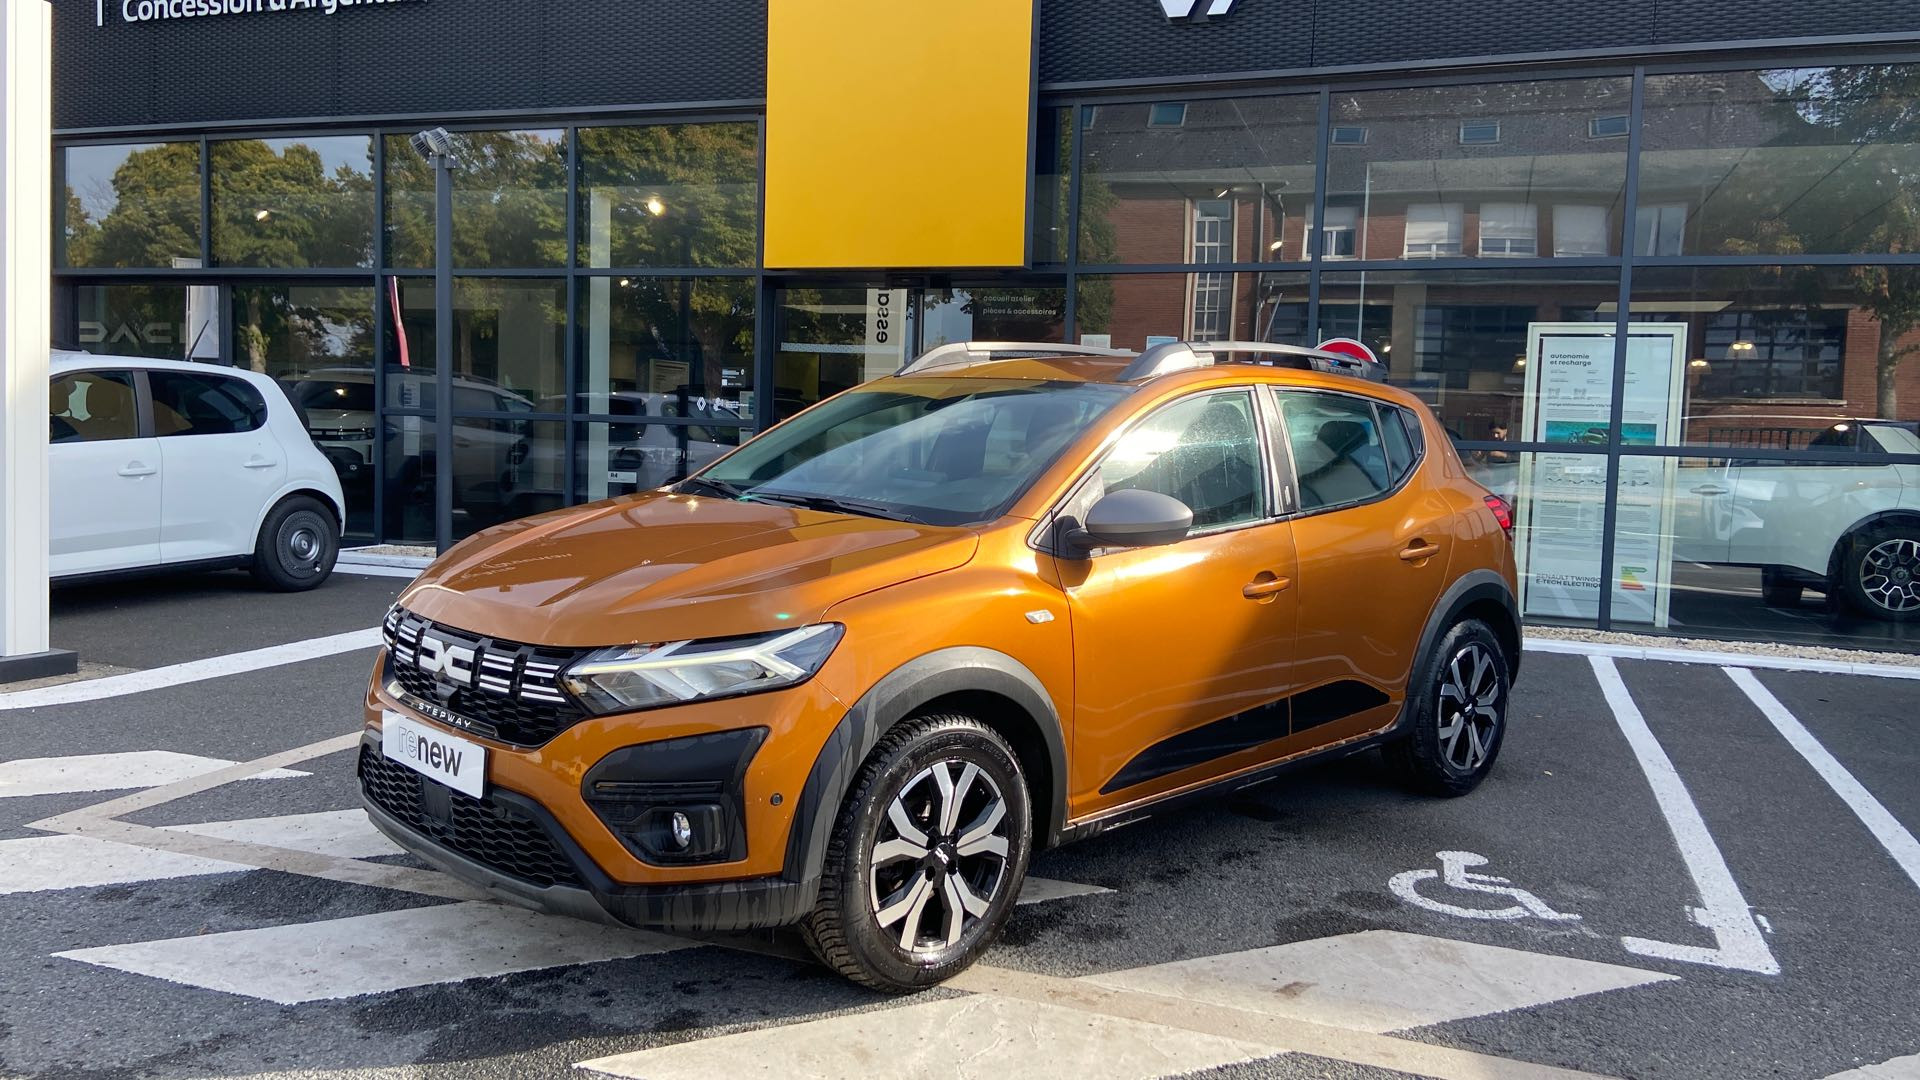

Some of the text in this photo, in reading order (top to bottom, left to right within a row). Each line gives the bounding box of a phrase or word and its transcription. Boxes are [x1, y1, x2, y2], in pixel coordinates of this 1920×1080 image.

[122, 0, 263, 22] Concession
[1536, 578, 1602, 589] E-TECH ELECTRIQ
[418, 702, 471, 728] STEPWAY
[399, 726, 463, 777] renew
